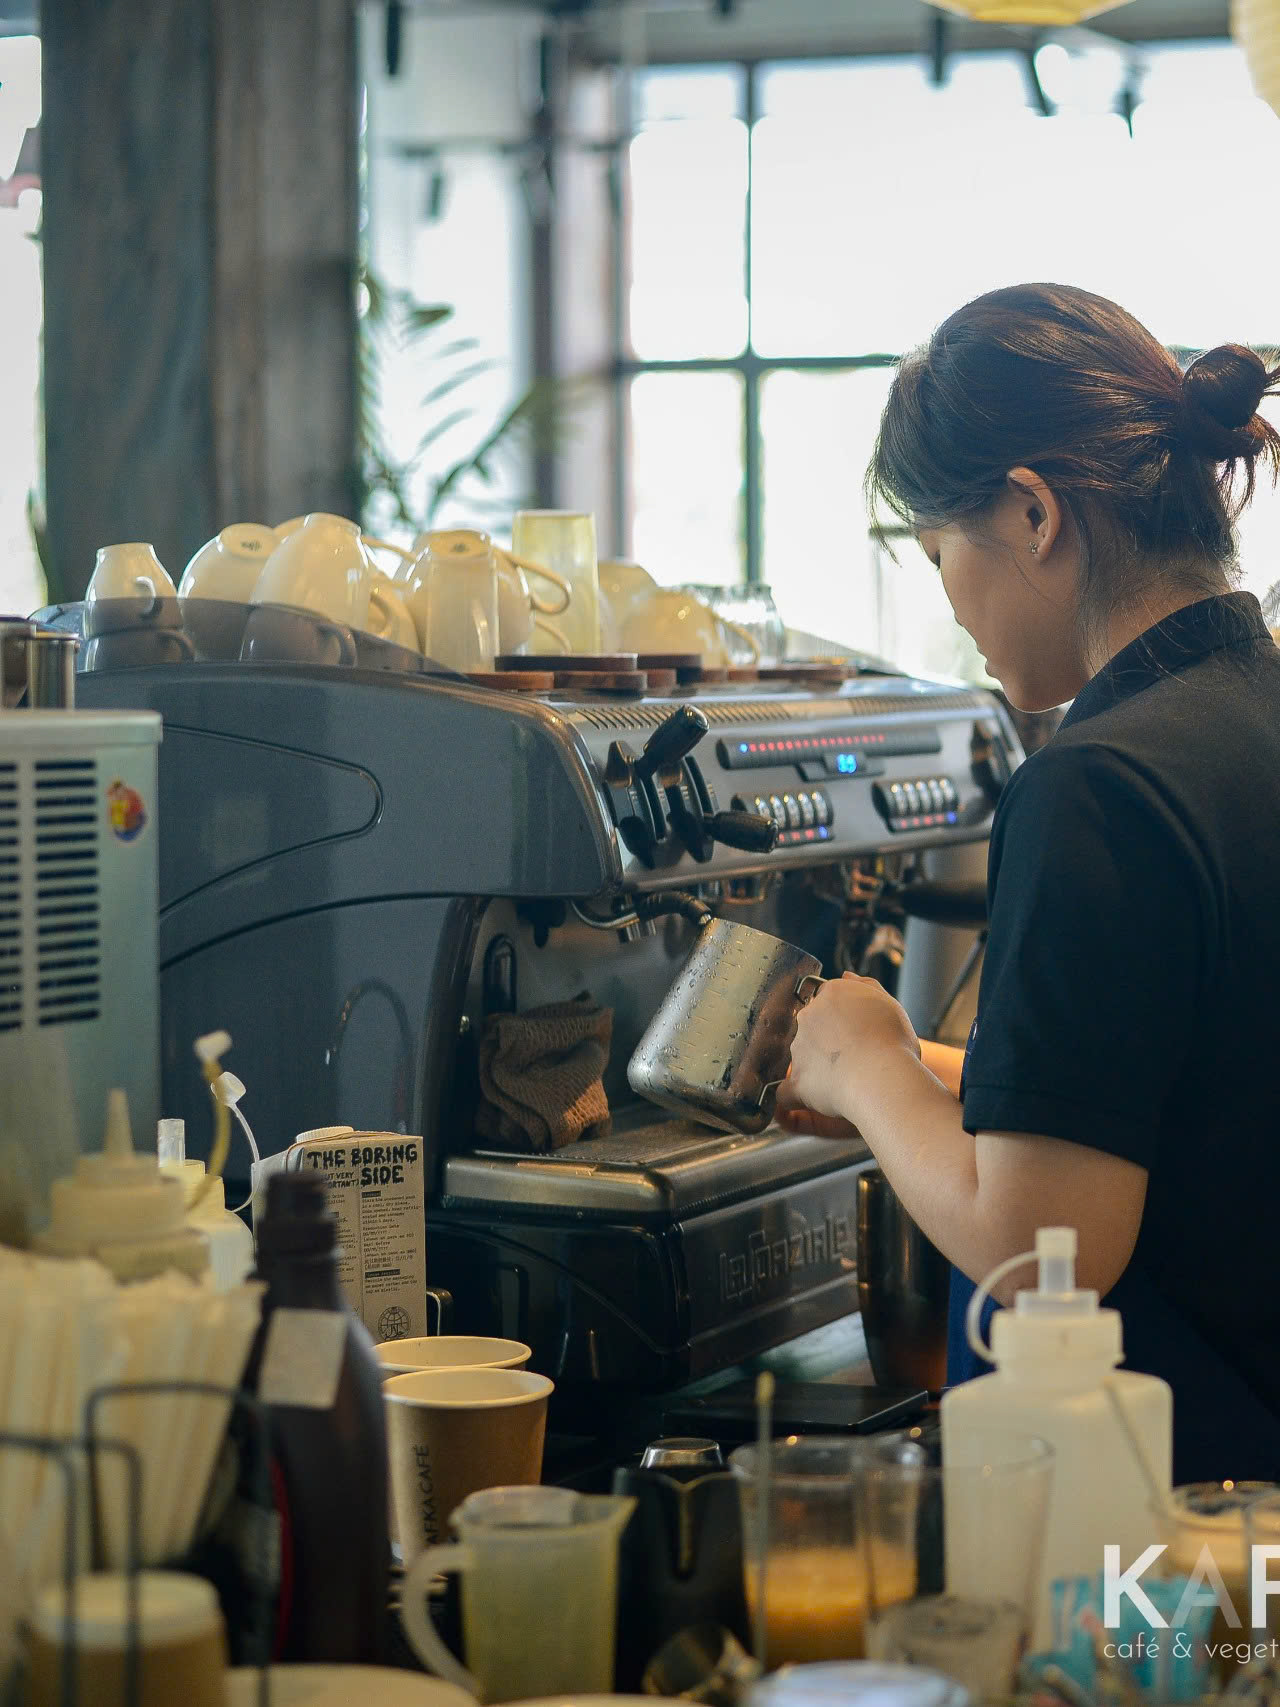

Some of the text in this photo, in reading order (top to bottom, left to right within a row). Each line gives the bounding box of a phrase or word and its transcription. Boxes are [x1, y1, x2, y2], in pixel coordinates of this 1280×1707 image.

[307, 1143, 417, 1169] THE BORING
[327, 1179, 360, 1189] ORTANT)
[335, 1171, 355, 1179] VERY
[360, 1165, 404, 1187] SIDE
[421, 1496, 440, 1545] AFKA
